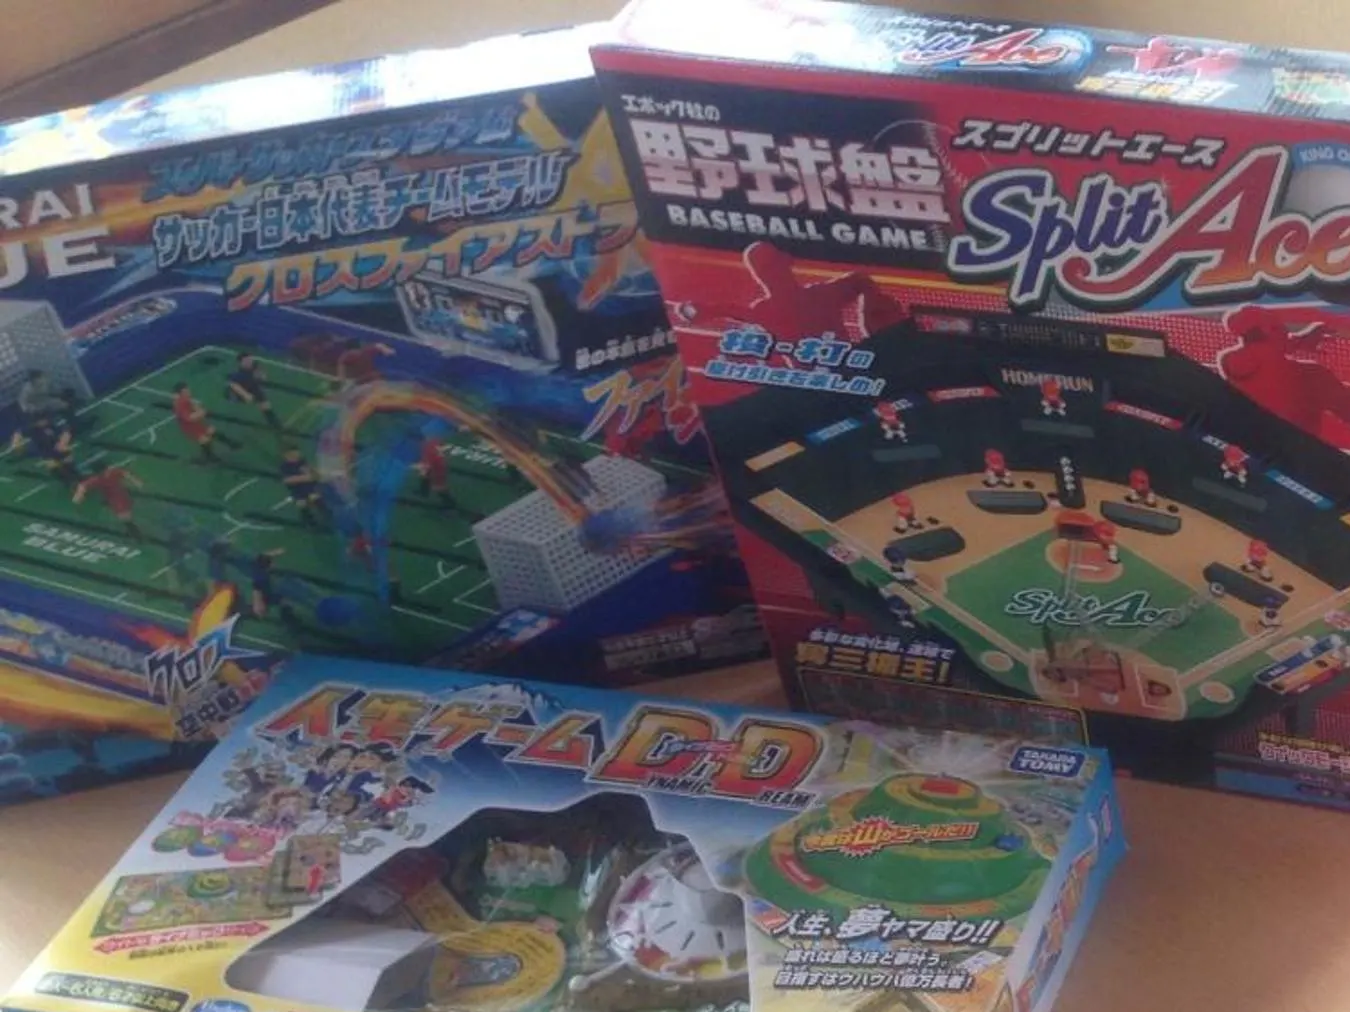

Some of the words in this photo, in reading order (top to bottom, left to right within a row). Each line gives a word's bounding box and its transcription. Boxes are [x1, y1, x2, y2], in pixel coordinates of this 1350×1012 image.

[952, 117, 1225, 167] スプリットエース
[1299, 146, 1335, 165] KING
[629, 117, 952, 224] 野球盤
[666, 203, 825, 241] BASEBALL
[831, 222, 935, 250] GAME
[948, 168, 1170, 302] Split
[253, 681, 604, 771] 人生ゲーム
[1017, 759, 1073, 774] TOMY
